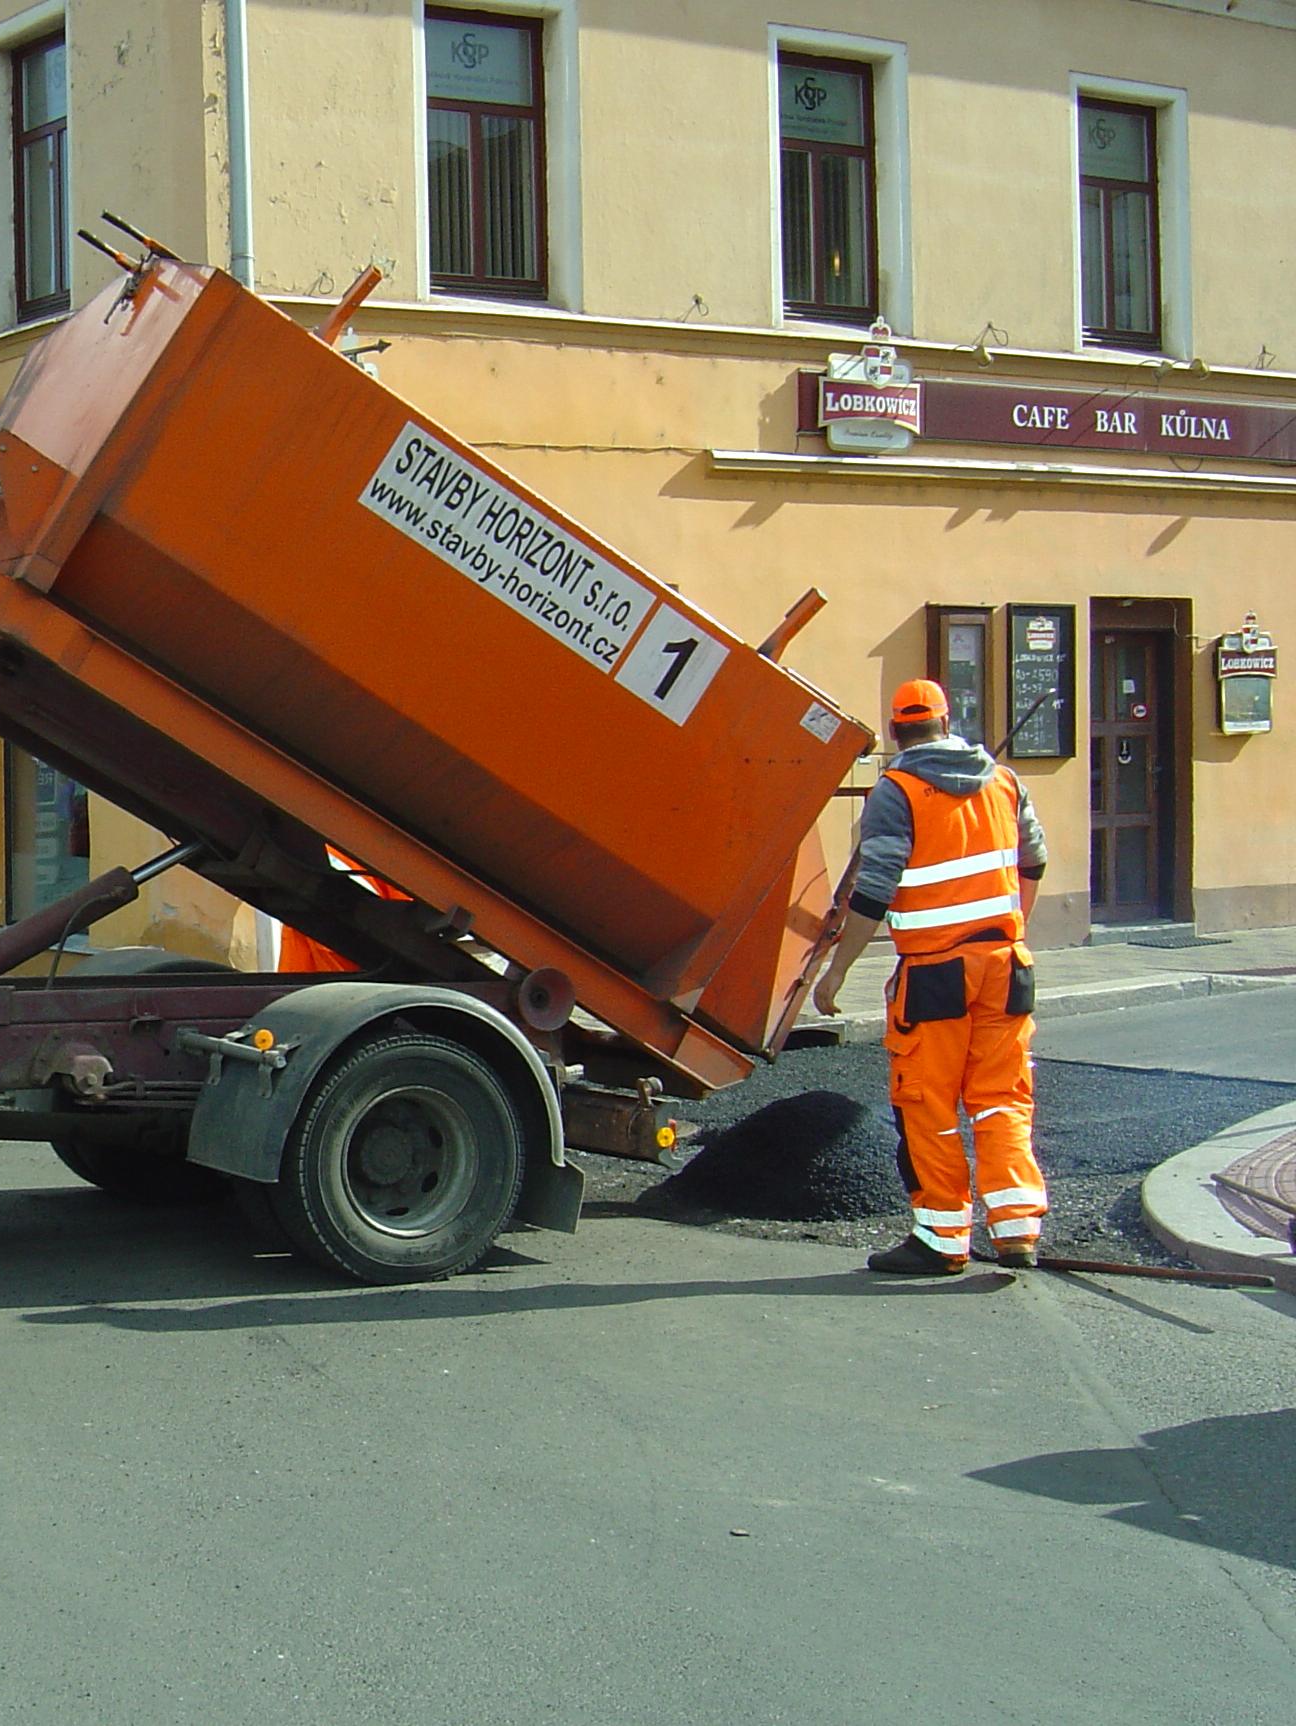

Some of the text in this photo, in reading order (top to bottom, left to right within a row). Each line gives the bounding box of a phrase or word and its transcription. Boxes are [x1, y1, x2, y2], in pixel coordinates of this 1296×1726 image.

[825, 391, 917, 417] LOBKOWICZ
[1012, 403, 1231, 441] CAFE BAR KŮLNA
[395, 437, 632, 632] STAVBY HORIZONT s.r.o.
[369, 477, 621, 666] www.stavby-horizont.cz
[653, 637, 700, 701] 1
